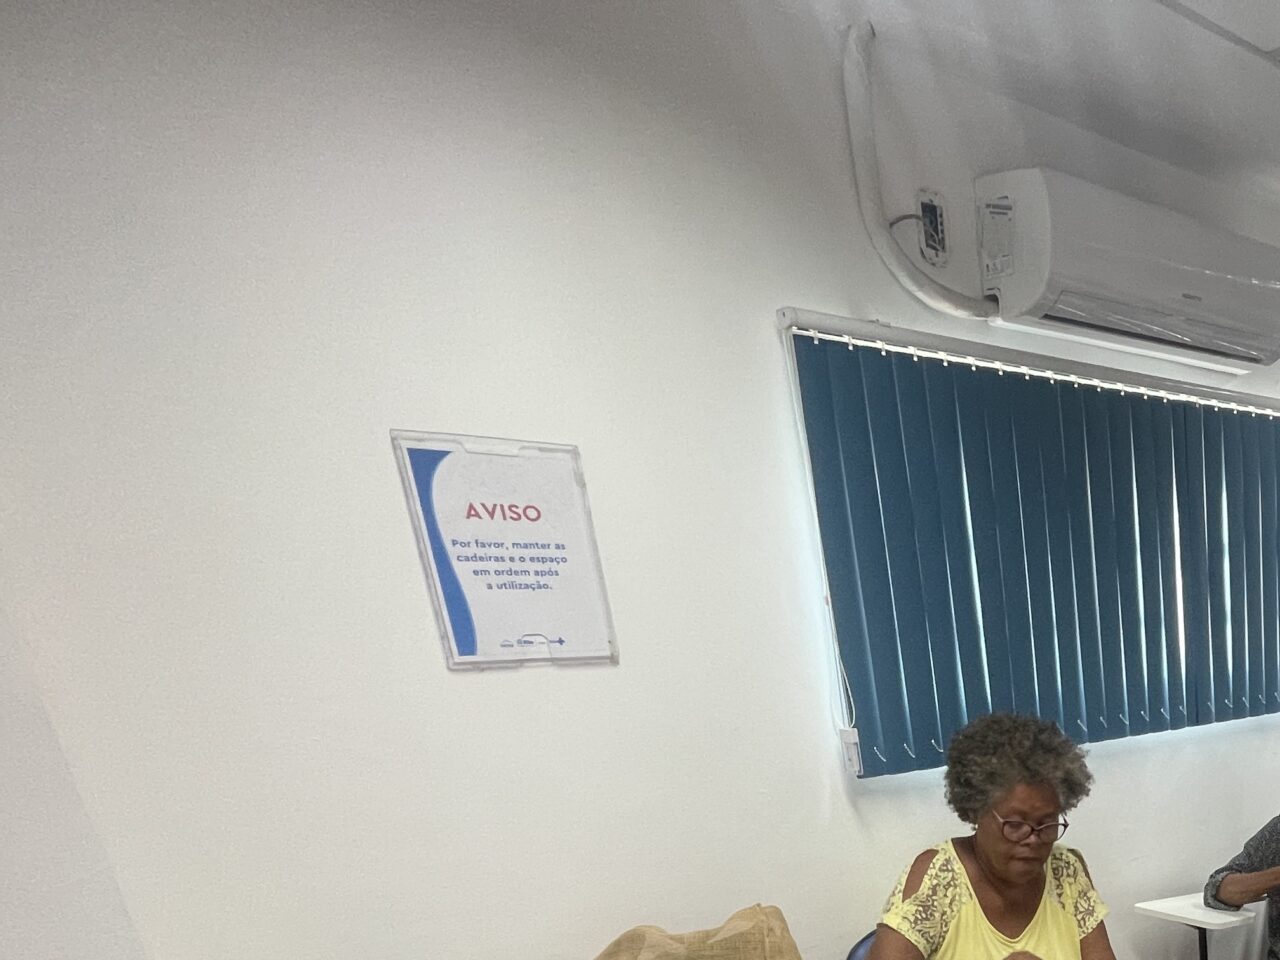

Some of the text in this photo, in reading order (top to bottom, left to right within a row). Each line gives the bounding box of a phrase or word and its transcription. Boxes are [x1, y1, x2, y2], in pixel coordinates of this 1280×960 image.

[466, 502, 542, 522] AVISO
[451, 539, 471, 548] Por
[475, 539, 509, 550] favor,
[511, 541, 551, 550] manter
[456, 553, 568, 566] cadeiras e o espaço
[494, 567, 531, 576] ordem
[534, 567, 560, 577] após
[486, 580, 553, 591] a utilização.
